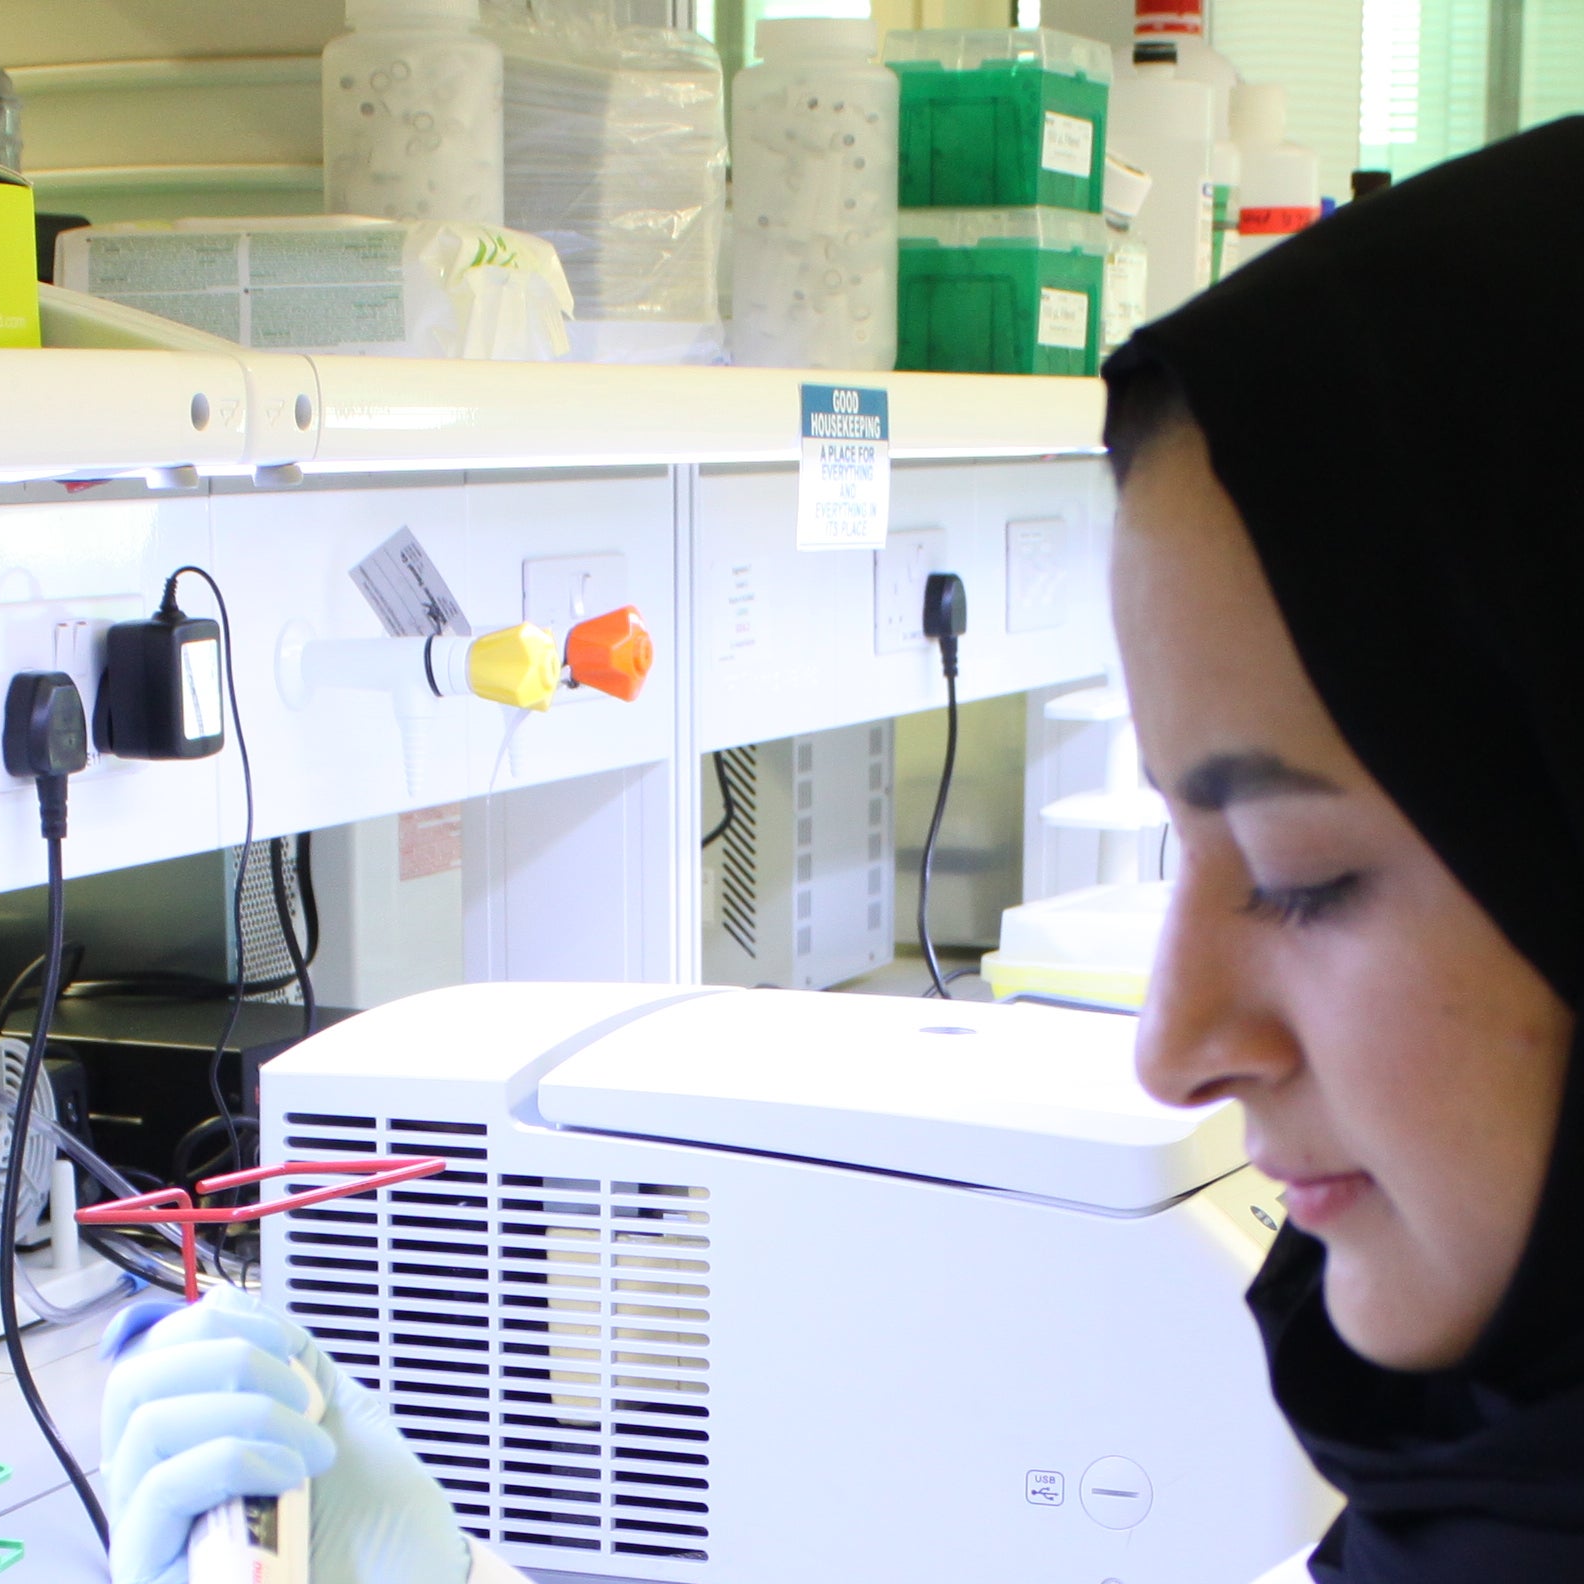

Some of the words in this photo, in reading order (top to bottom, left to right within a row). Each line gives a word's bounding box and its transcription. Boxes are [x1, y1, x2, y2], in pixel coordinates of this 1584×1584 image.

[832, 389, 859, 414] GOOD
[810, 412, 881, 439] HOUSEKEEPING
[820, 446, 827, 462] A
[828, 445, 856, 463] PLACE
[858, 446, 876, 464] FOR
[821, 463, 873, 481] EVERYTHING
[839, 483, 856, 499] AND
[815, 501, 866, 519] EVERYTHING
[869, 502, 877, 517] IN
[825, 520, 838, 537] ITS
[841, 521, 867, 537] PLACE
[1034, 1474, 1056, 1484] USB
